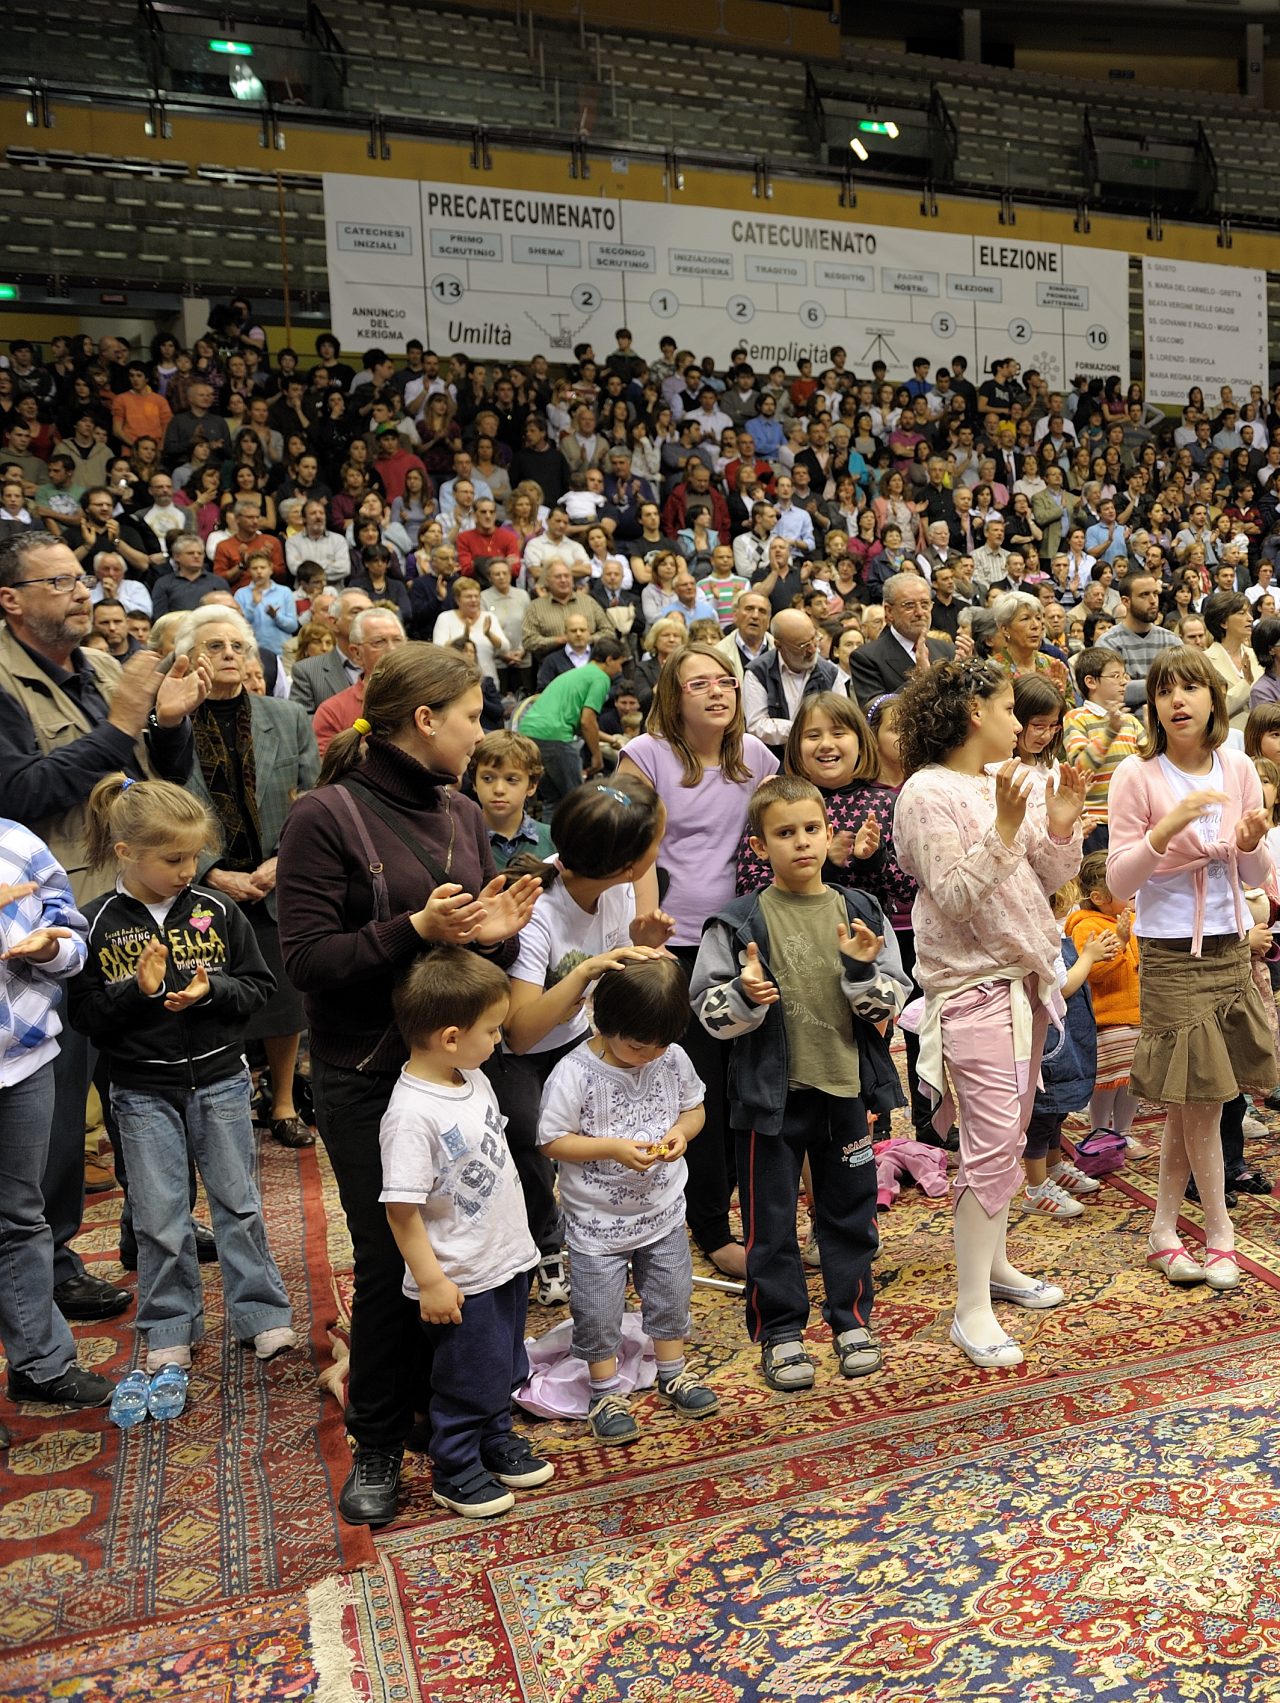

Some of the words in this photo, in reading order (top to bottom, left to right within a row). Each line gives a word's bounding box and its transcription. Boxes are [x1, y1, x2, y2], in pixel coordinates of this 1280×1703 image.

[428, 192, 615, 230] PRECATECUMENATO
[344, 226, 405, 238] CATECHESI
[732, 220, 877, 254] CATECUMENATO
[353, 239, 397, 250] INIZIALI
[450, 234, 483, 244] PRIMO
[439, 246, 496, 257] SCRUTINIO
[599, 247, 646, 257] SECONDO
[596, 258, 649, 269] SCRUTINIO
[674, 253, 731, 265] INIZIAZIONE
[980, 245, 1058, 272] ELEZIONE
[675, 266, 729, 277] PREGHIERA
[755, 265, 798, 276] TRADITIO
[434, 281, 461, 298] 13
[954, 284, 995, 294] ELEZIONE
[581, 291, 593, 306] 2
[659, 298, 667, 310] 1
[352, 307, 406, 319] ANNUNCIO
[736, 302, 747, 316] 2
[808, 308, 818, 321] 6
[370, 319, 389, 329] DEL
[939, 319, 949, 332] 5
[357, 329, 404, 340] KERIGMA
[448, 320, 512, 346] Umiltà
[1016, 325, 1025, 338] 2
[1089, 331, 1107, 344] 10
[1075, 361, 1120, 372] FORMAZIONE
[111, 931, 150, 946] DANCING
